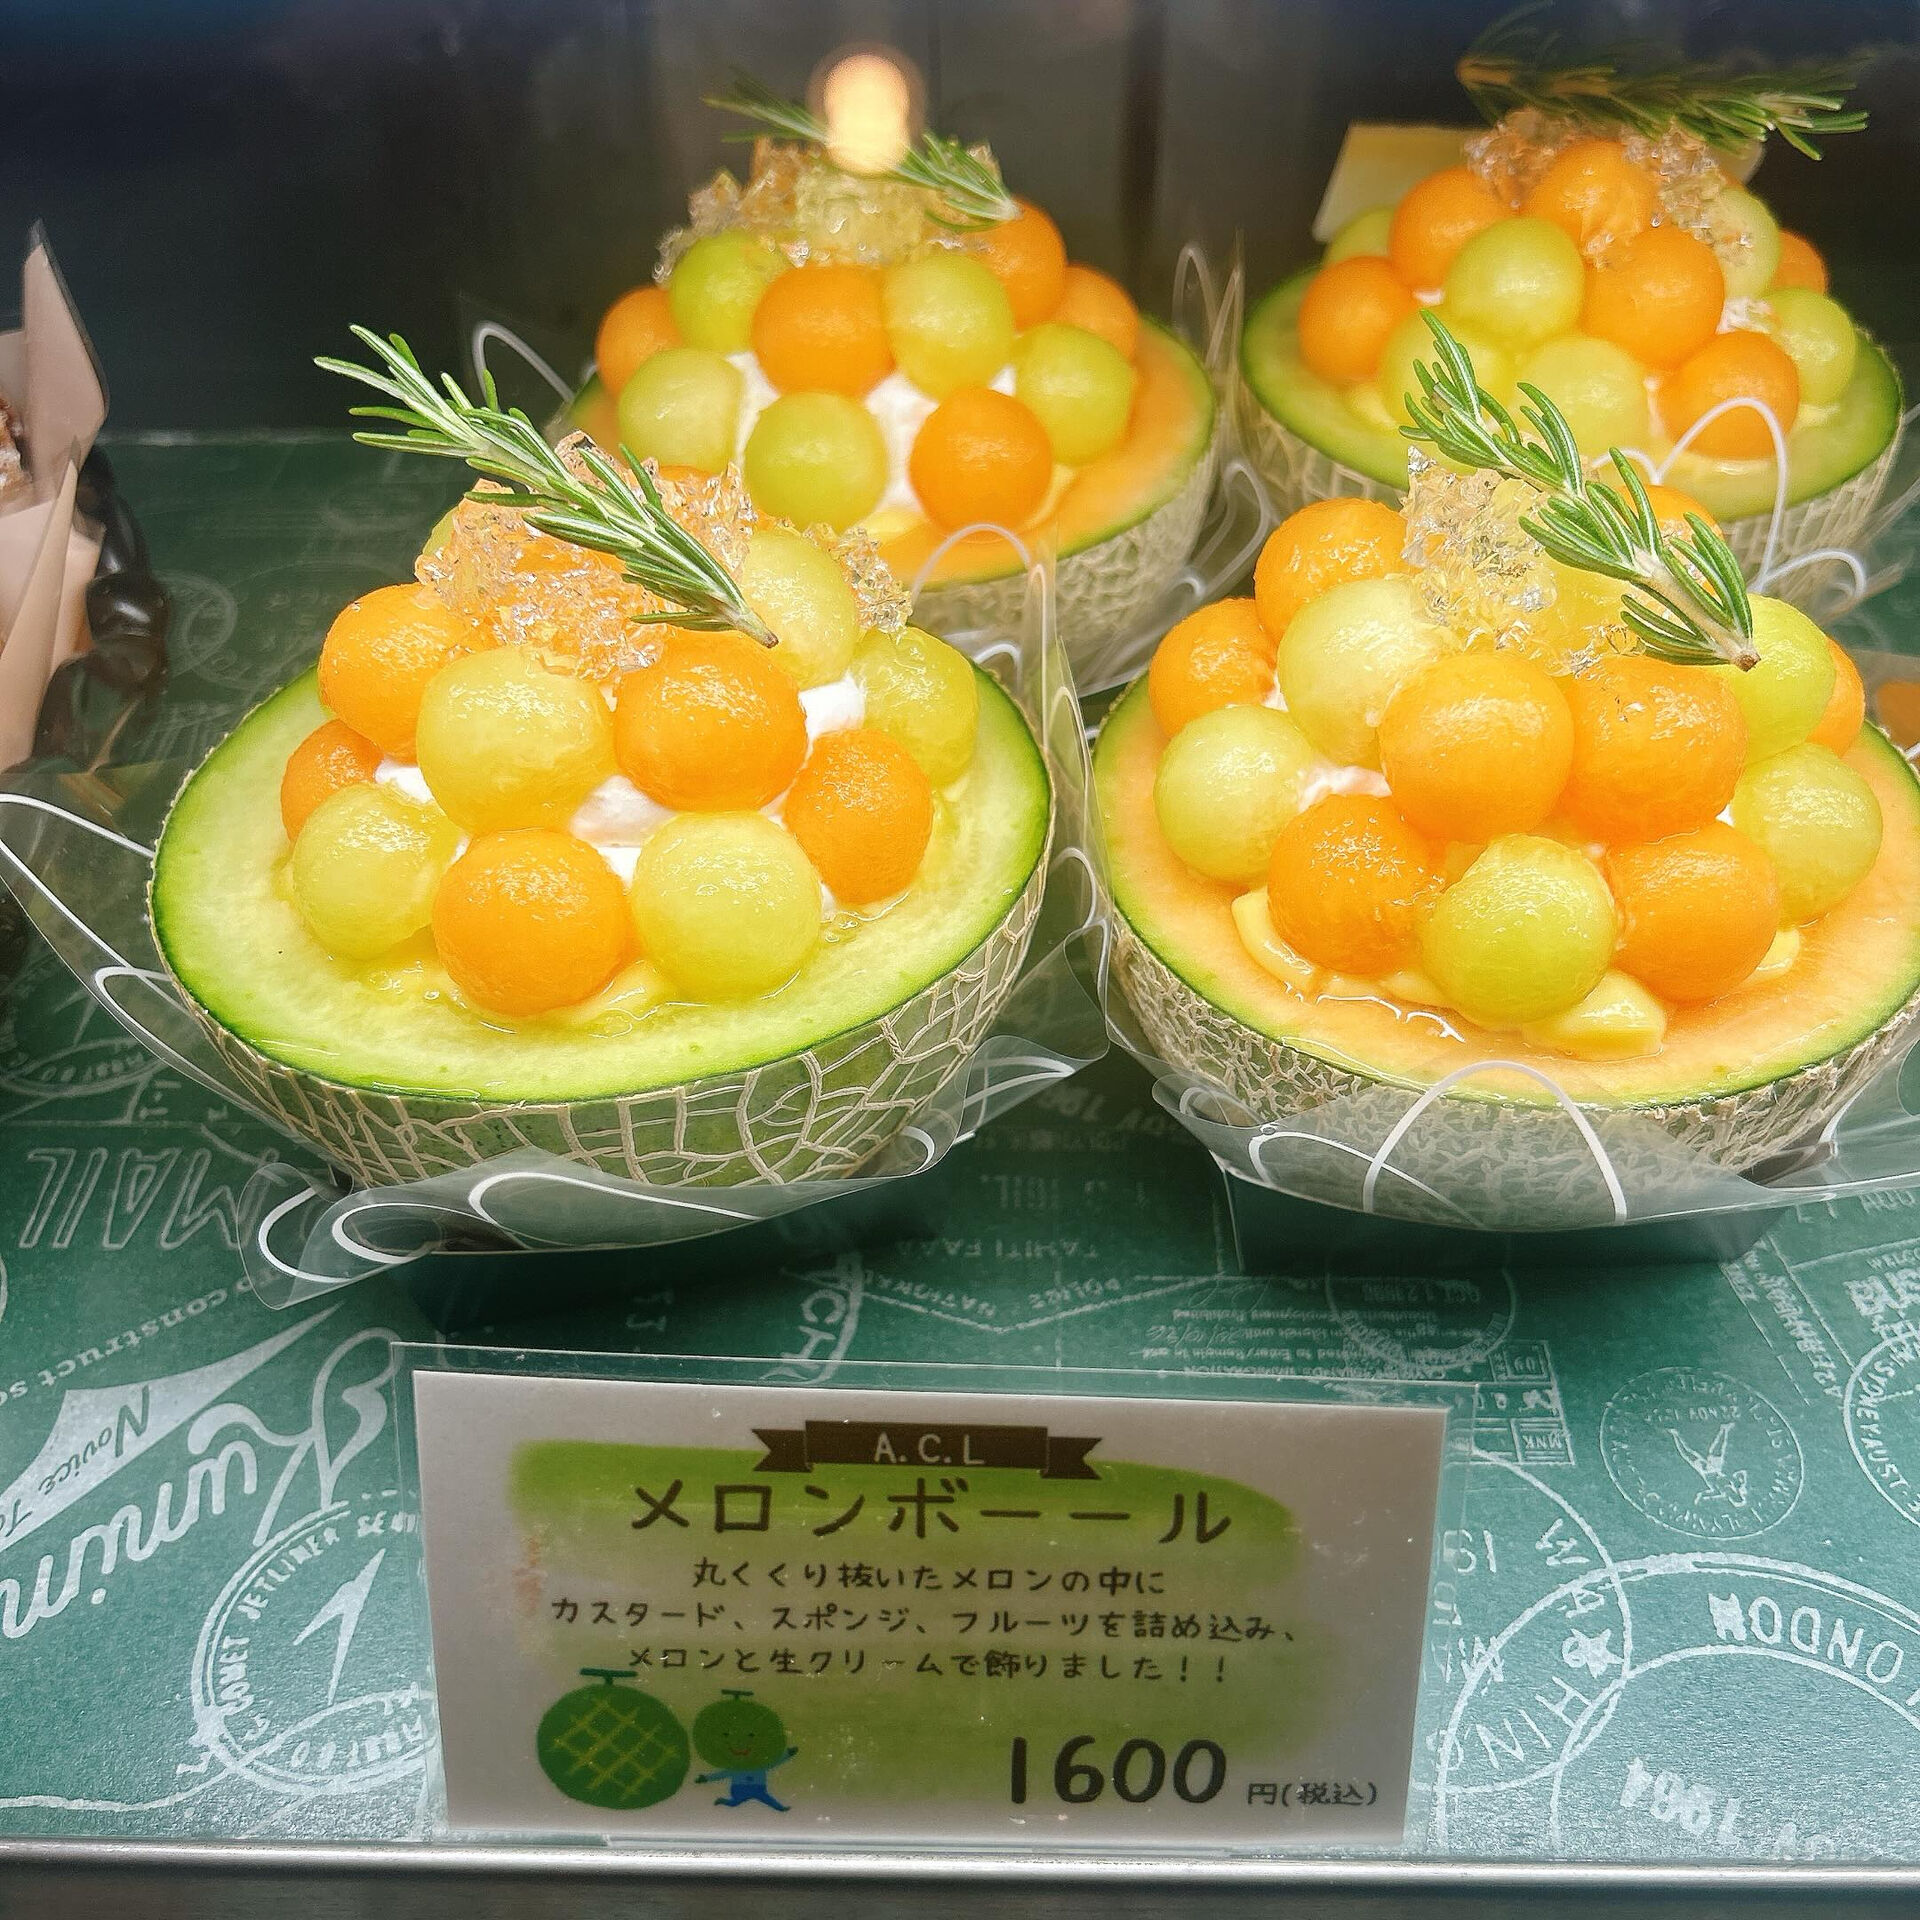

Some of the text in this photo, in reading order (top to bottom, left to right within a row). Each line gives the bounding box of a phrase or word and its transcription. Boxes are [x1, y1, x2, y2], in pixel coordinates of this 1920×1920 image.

[38, 1287, 229, 1388] construct
[873, 1431, 987, 1466] A.C.L
[631, 1476, 1232, 1545] メロンボーール
[692, 1556, 1165, 1597] 丸くくり抜いたメロンの中に
[1010, 1734, 1378, 1807] 1600 円(税込)
